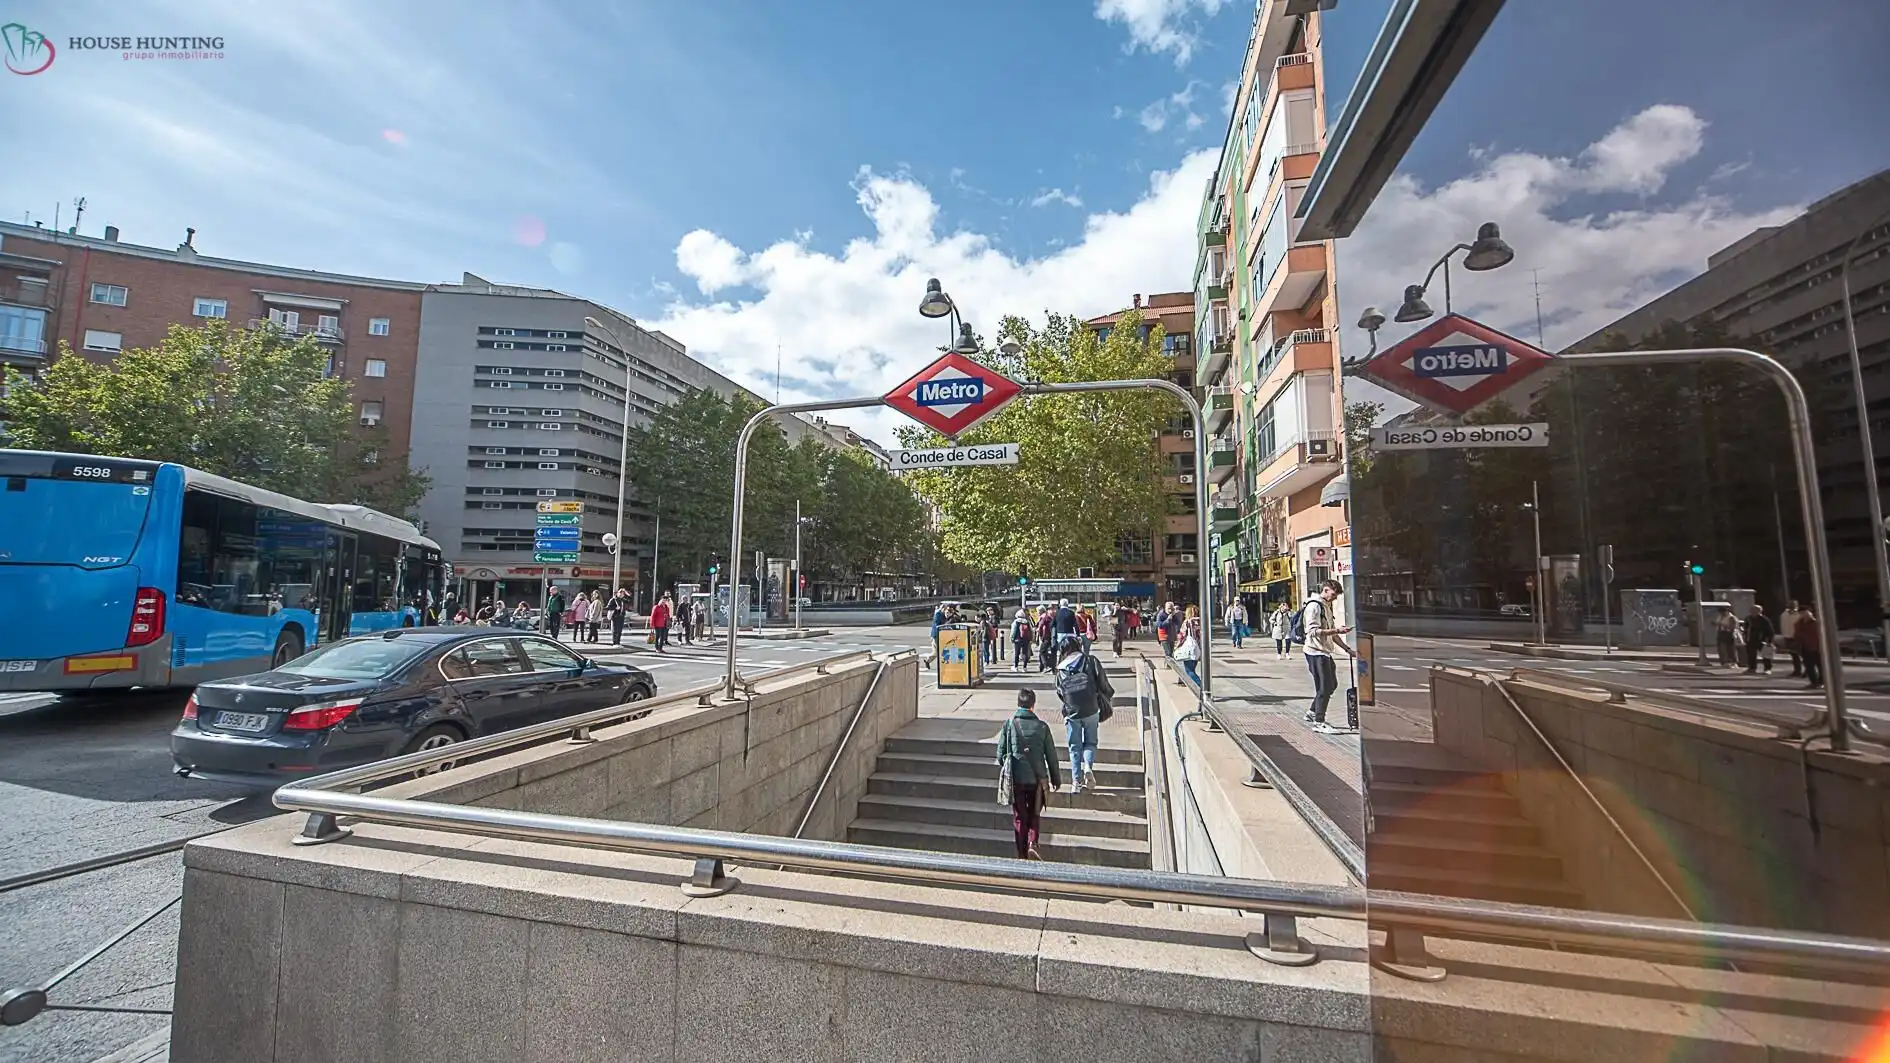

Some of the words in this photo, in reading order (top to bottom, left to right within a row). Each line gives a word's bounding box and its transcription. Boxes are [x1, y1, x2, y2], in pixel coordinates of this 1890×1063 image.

[922, 382, 979, 401] Metro
[900, 450, 944, 465] Conde
[946, 449, 965, 462] de
[967, 446, 1008, 460] Casal
[72, 466, 111, 478] 5598
[0, 660, 35, 672] SP
